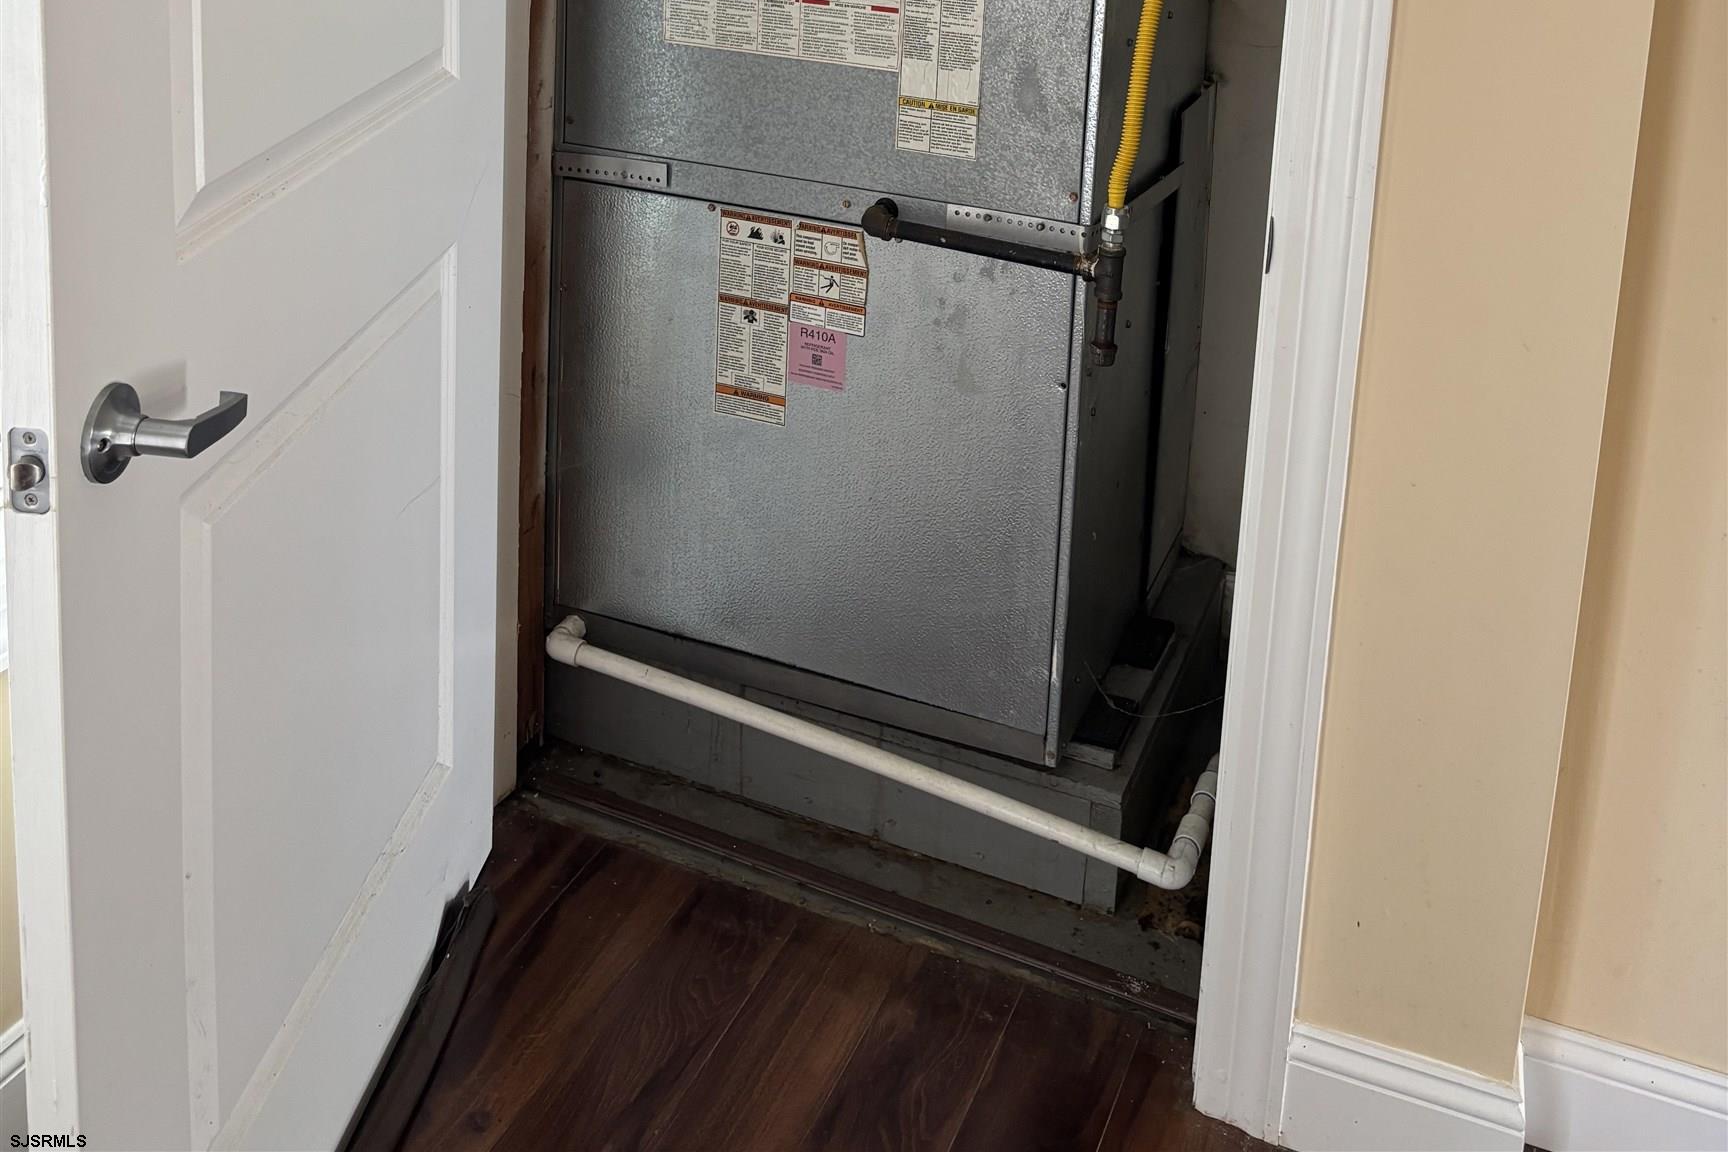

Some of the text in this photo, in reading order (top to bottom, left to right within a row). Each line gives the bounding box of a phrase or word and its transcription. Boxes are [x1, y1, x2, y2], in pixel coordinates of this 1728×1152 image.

[902, 98, 926, 108] CAUTION
[800, 327, 836, 344] R410A
[740, 391, 769, 402] WARNING
